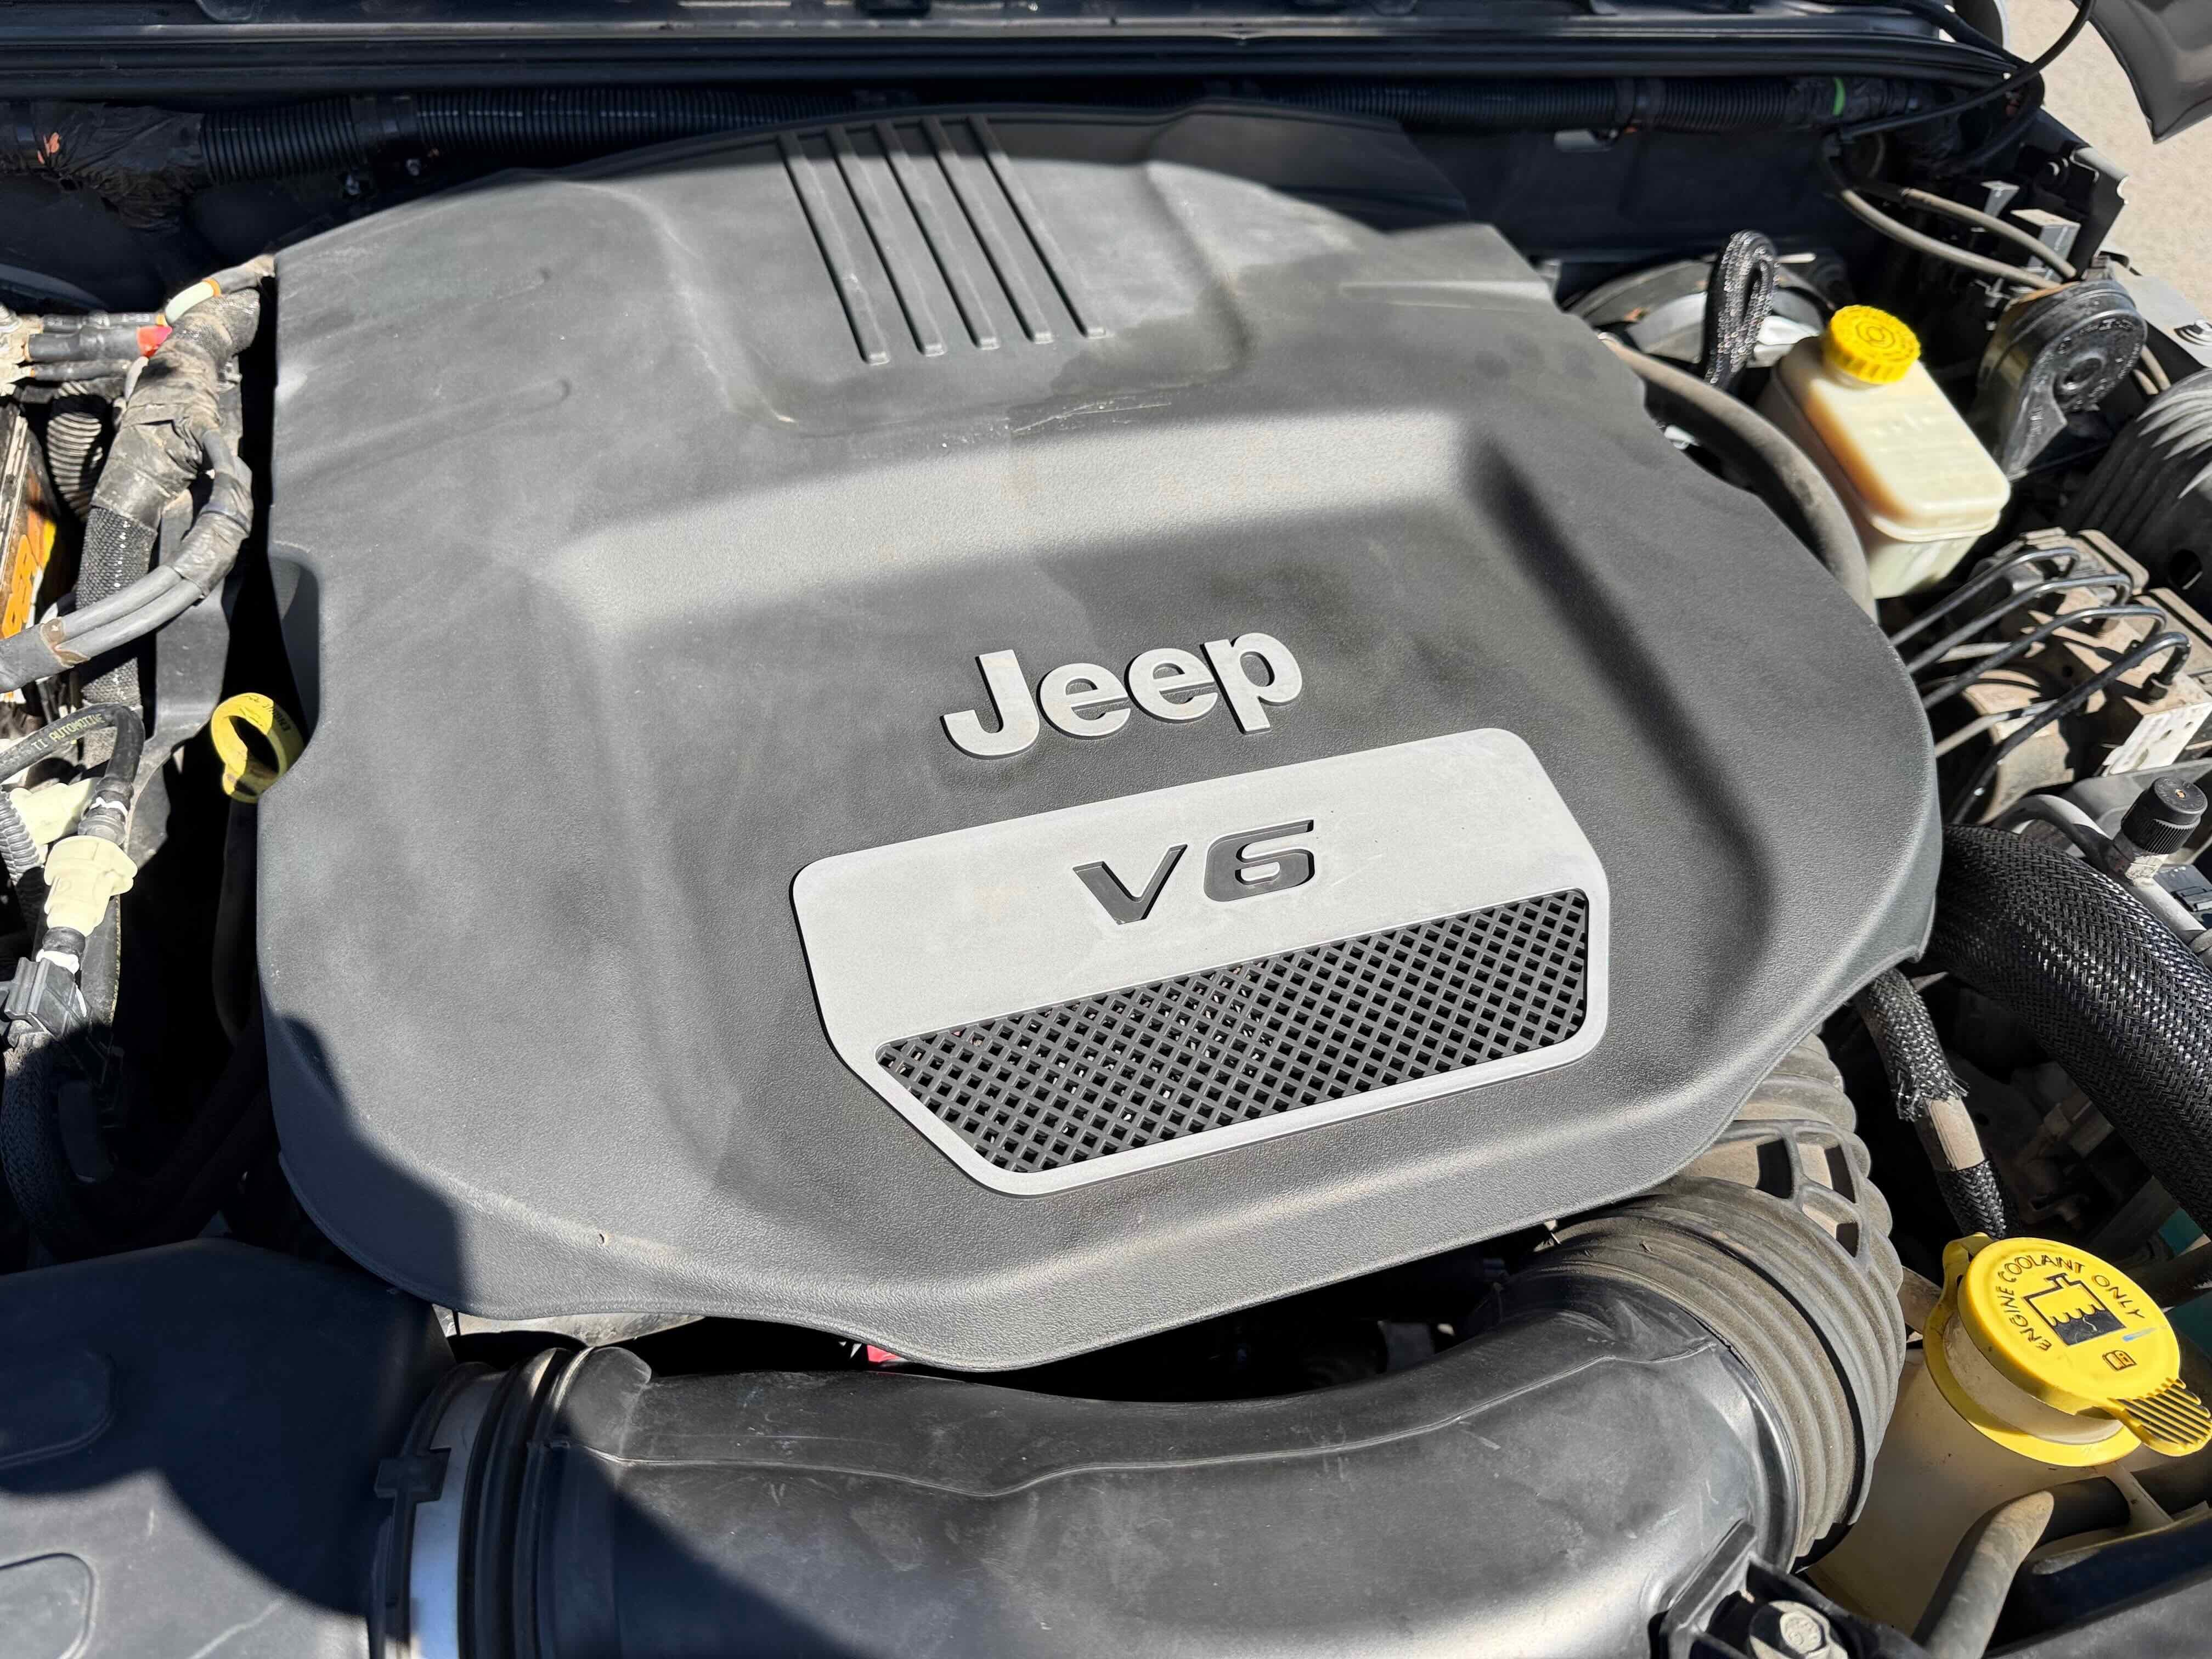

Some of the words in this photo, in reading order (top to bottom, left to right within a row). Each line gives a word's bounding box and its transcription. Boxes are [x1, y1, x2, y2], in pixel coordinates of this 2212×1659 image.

[941, 632, 1303, 760] Jeep
[1072, 819, 1315, 926] V6
[1997, 1255, 2085, 1283] COOLANT
[2091, 1274, 2146, 1319] ONLY
[1996, 1285, 2052, 1351] ENGINE
